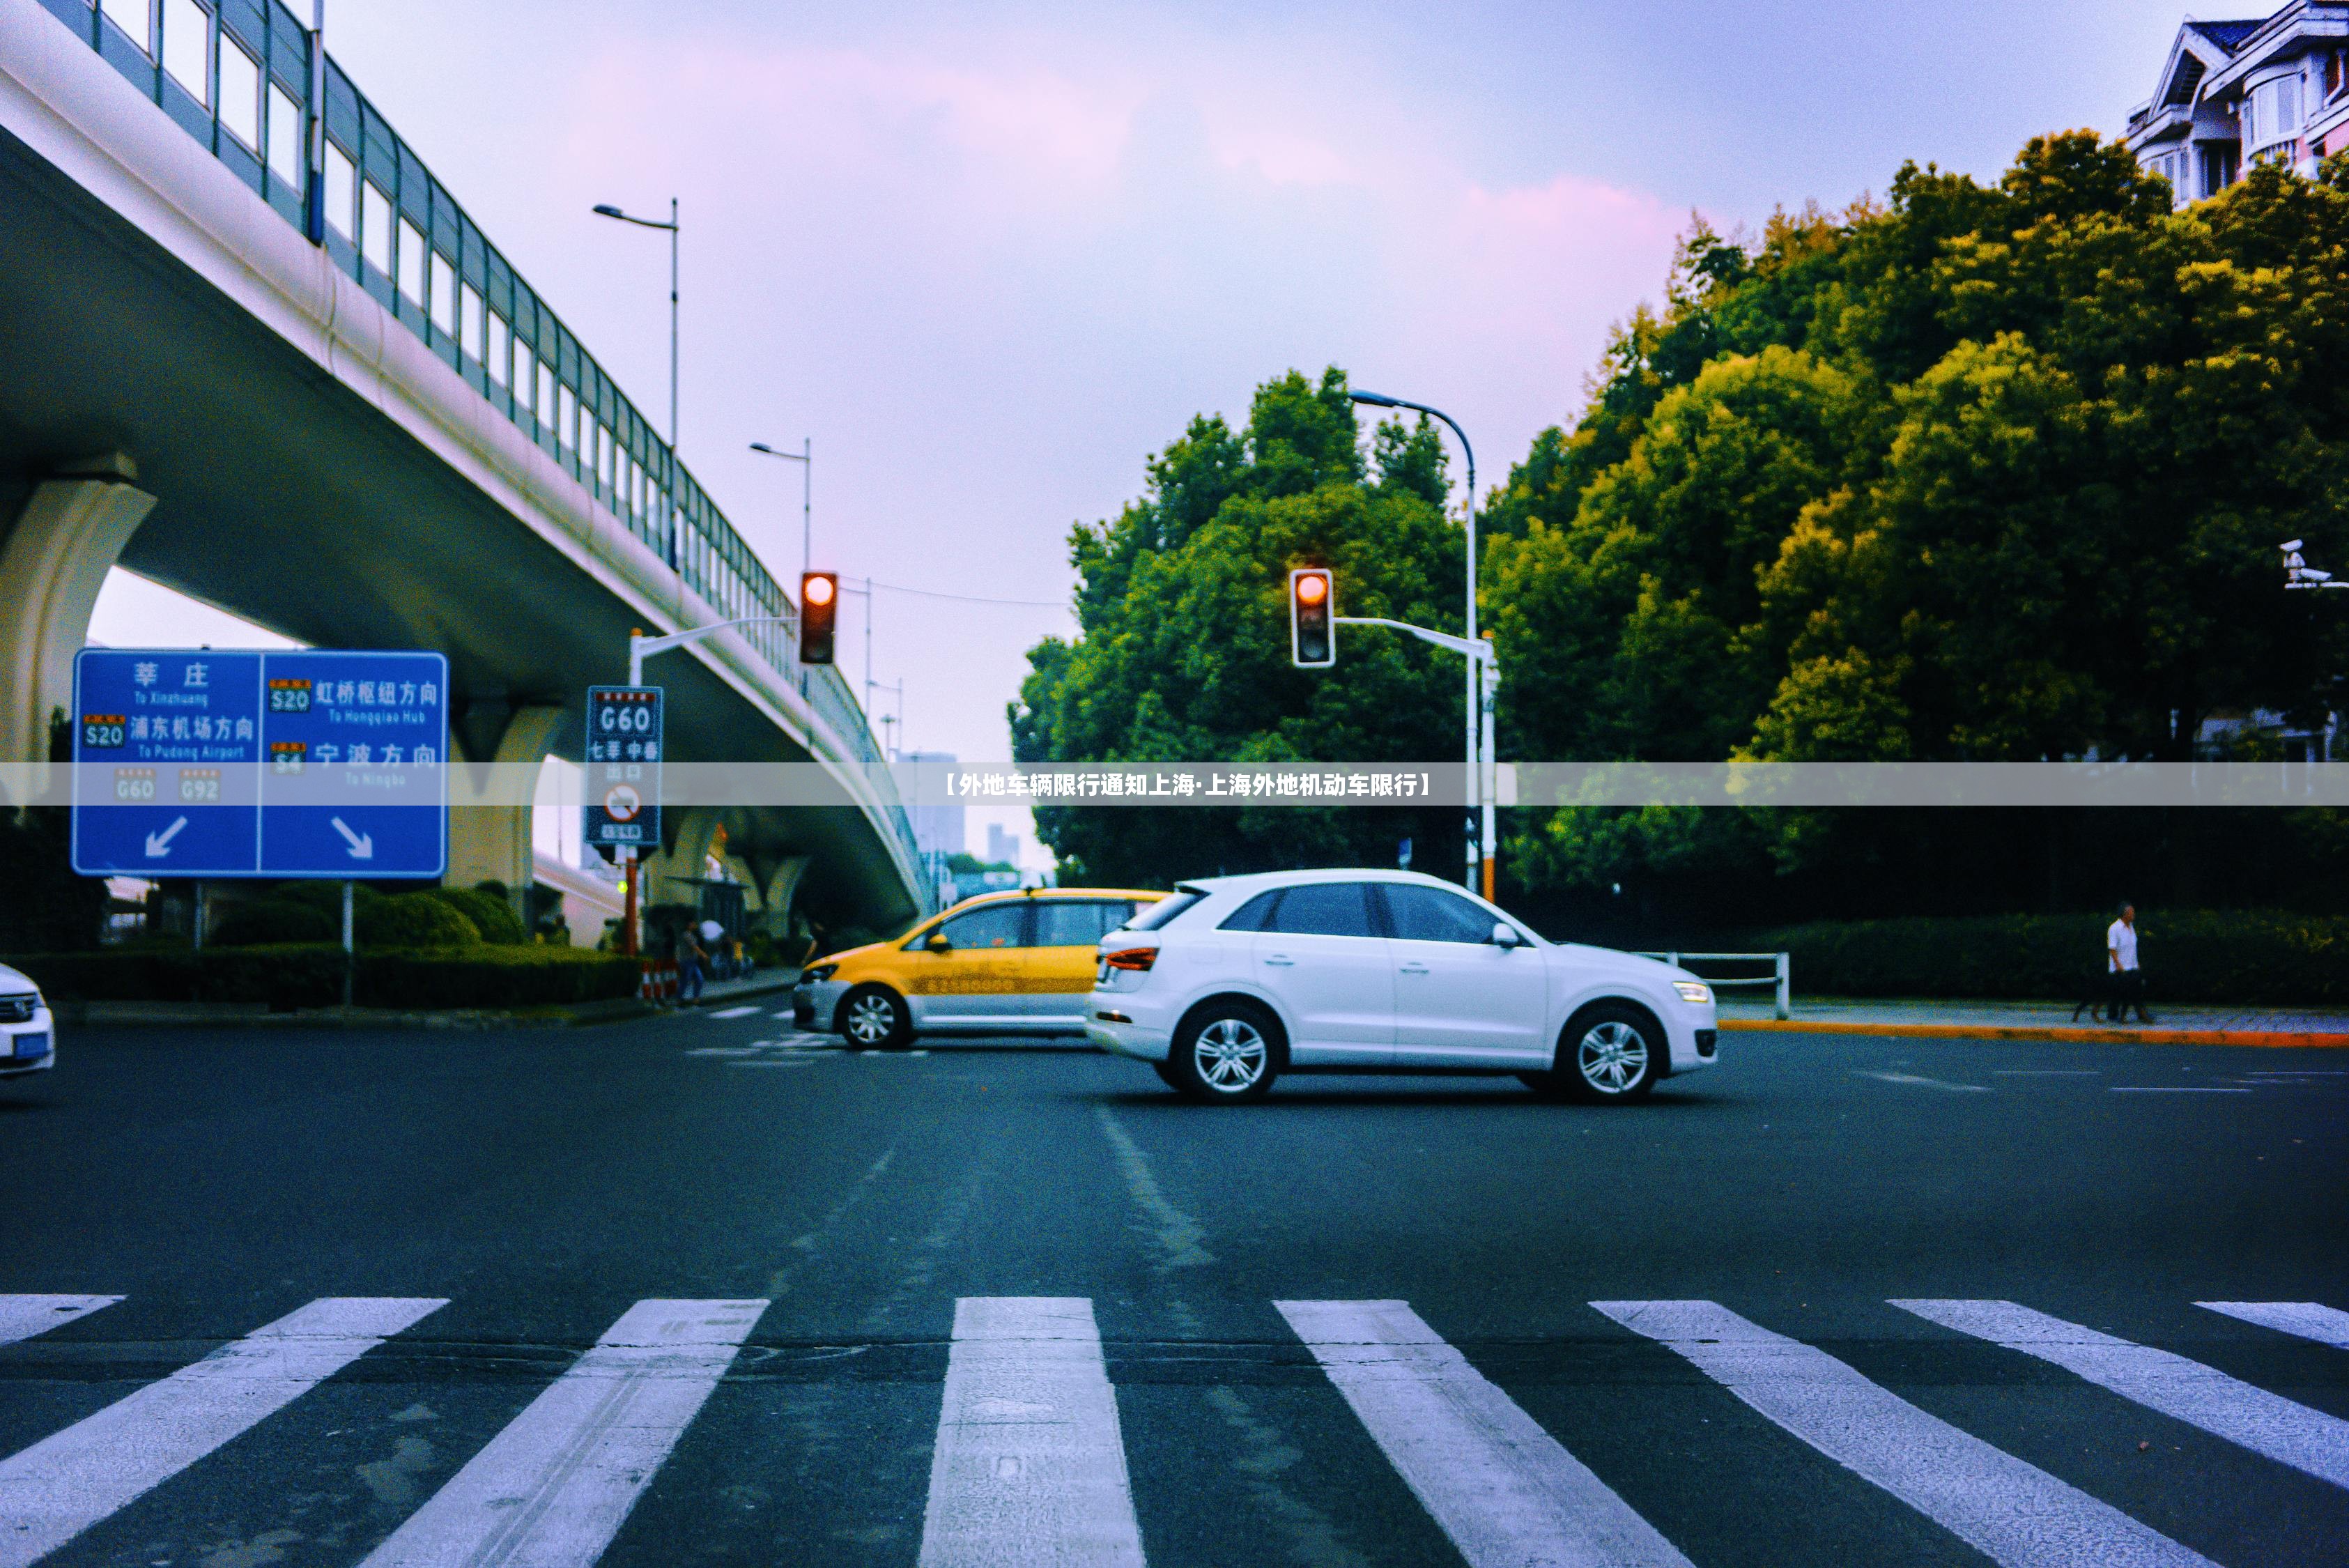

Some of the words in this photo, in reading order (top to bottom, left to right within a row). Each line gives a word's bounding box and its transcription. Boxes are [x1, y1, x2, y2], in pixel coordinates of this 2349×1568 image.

[134, 662, 209, 687] 莘庄
[134, 691, 146, 704] To
[271, 691, 309, 708] S20
[316, 681, 437, 706] 虹桥枢纽方向
[329, 709, 341, 721] To
[346, 709, 399, 725] Hongqiao
[403, 710, 426, 723] Hub
[601, 707, 649, 730] G60
[86, 725, 123, 745] S20
[130, 716, 253, 740] 浦东机场方向
[139, 744, 151, 758] To
[202, 746, 244, 760] Airport
[316, 743, 436, 767] 宁波方向
[275, 753, 302, 773] S4
[117, 780, 154, 798] G60
[181, 780, 219, 800] G92
[363, 773, 406, 788] Ningbo
